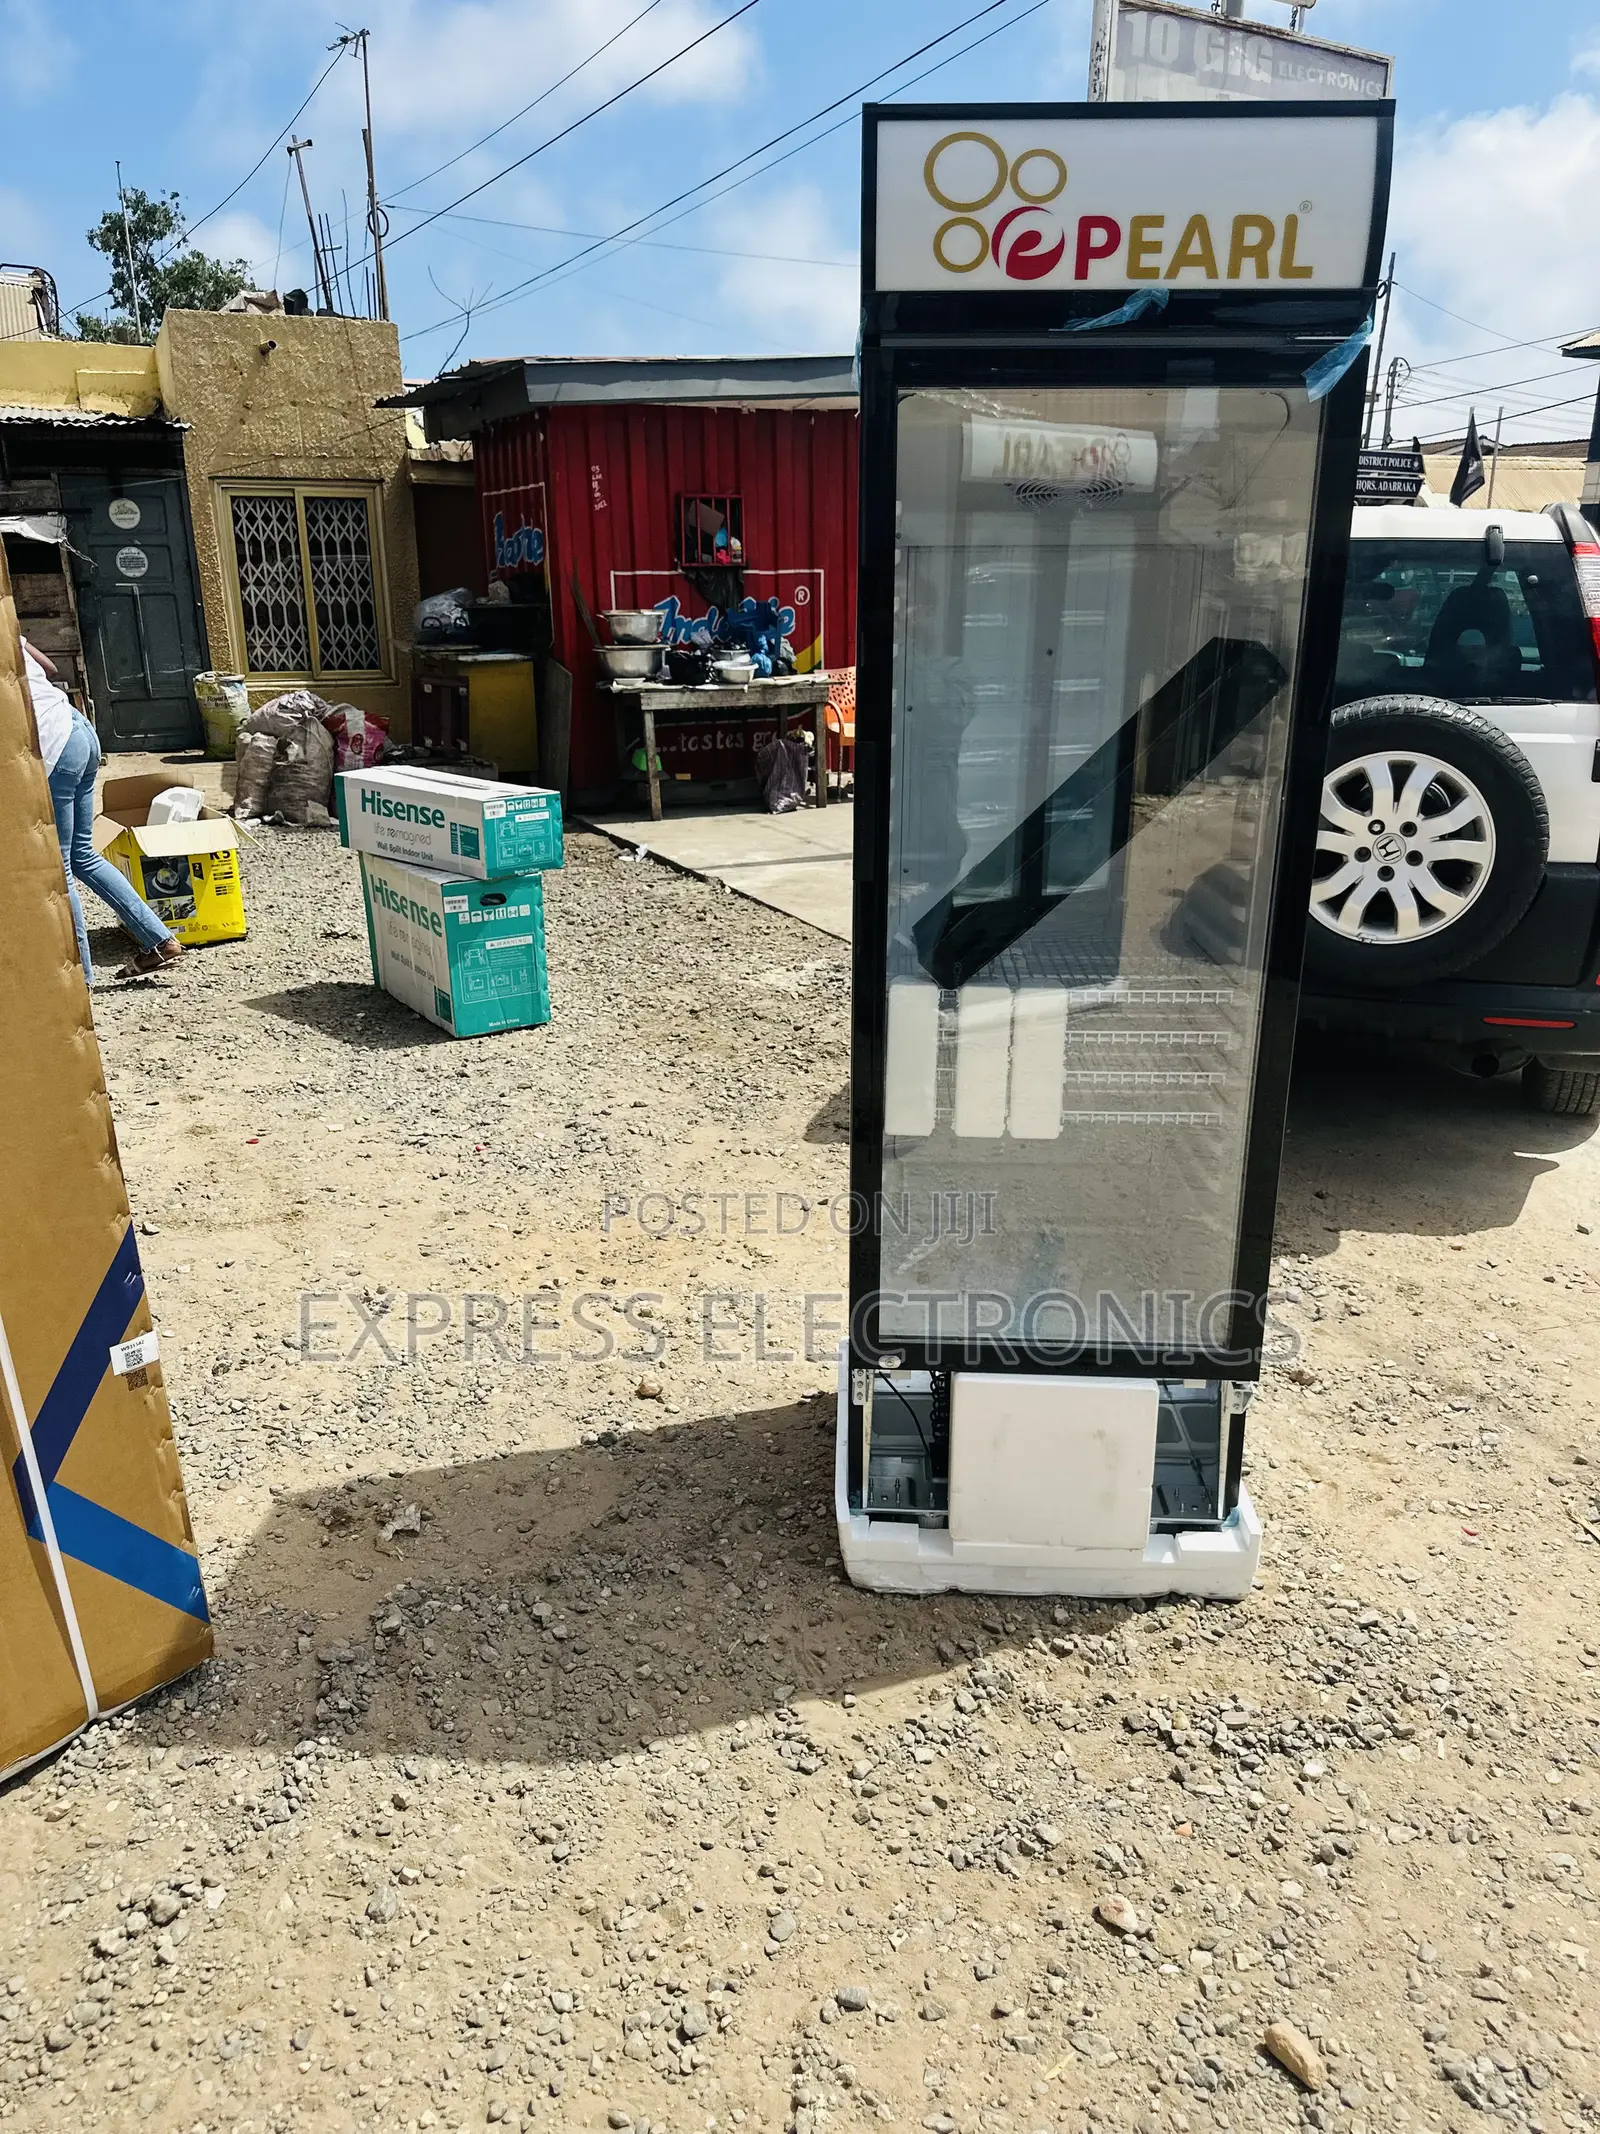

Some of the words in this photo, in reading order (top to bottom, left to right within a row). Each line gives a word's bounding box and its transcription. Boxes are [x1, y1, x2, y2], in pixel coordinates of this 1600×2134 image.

[1124, 13, 1181, 64] 10
[1278, 62, 1384, 97] ELECTRONICS
[1074, 213, 1314, 281] PEARL
[1358, 455, 1388, 467] DISTRICT
[1388, 457, 1412, 469] POLICE
[1377, 481, 1417, 493] ADABRAKA
[361, 788, 446, 829] Hisense
[376, 840, 388, 851] Wall
[389, 843, 402, 855] Split
[402, 846, 421, 858] Indoor
[421, 850, 434, 862] Unit
[369, 873, 443, 938] Hisense
[496, 938, 528, 947] WARNING
